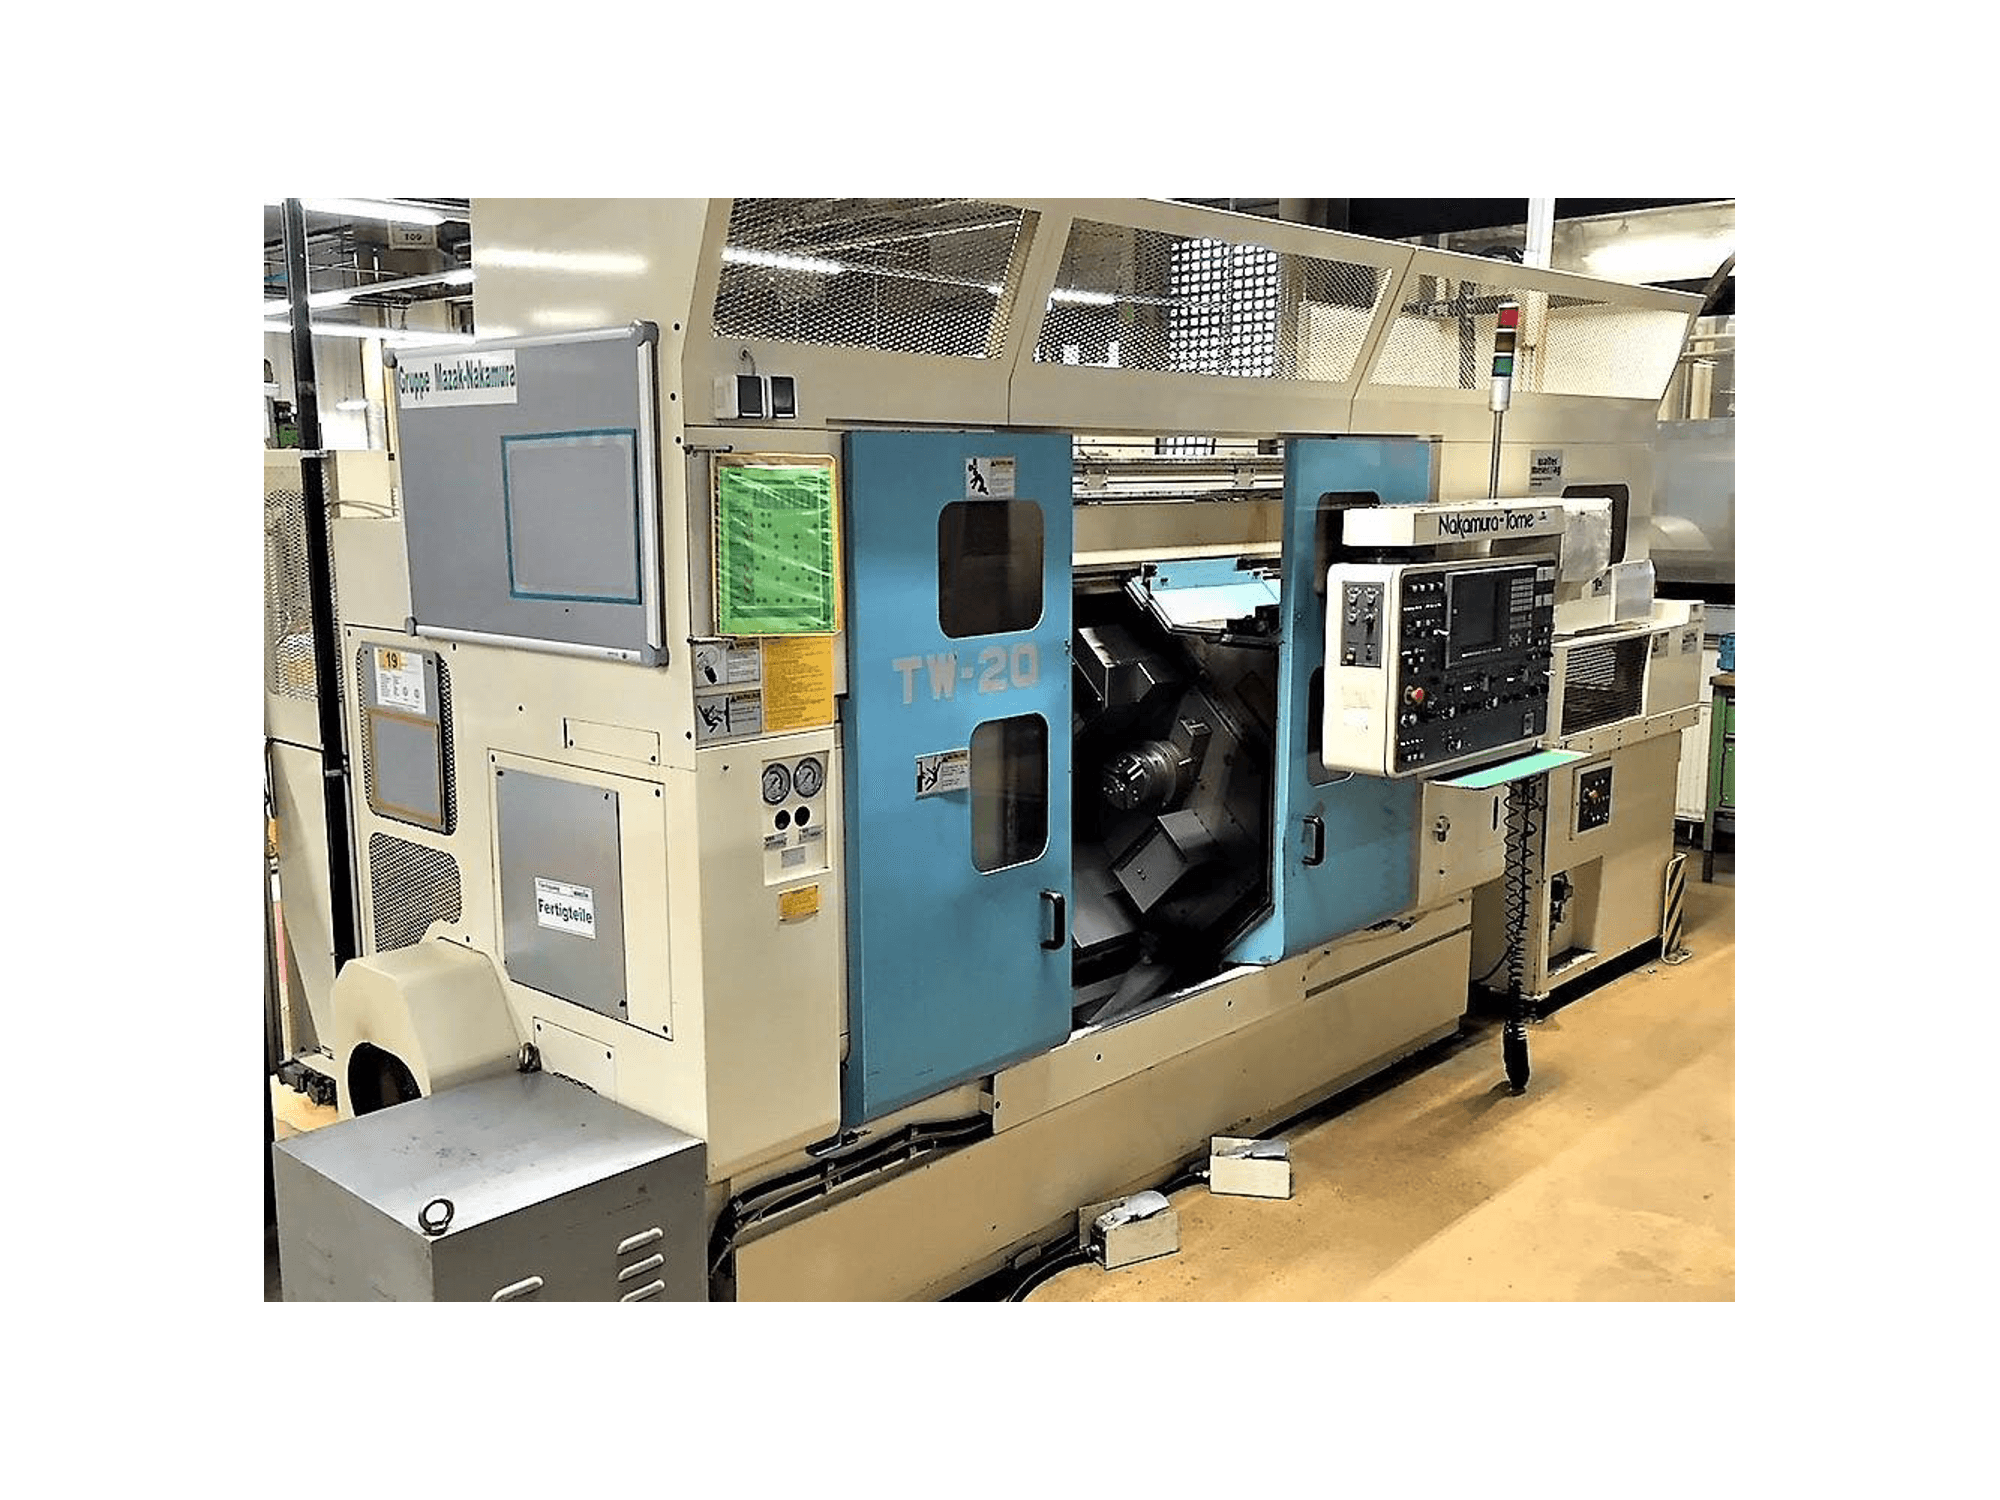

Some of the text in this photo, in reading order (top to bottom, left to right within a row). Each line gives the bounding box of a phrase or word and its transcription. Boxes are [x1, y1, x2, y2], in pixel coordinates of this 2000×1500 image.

[399, 360, 515, 400] Gruppe Mazak-Nakamura
[1438, 509, 1534, 539] Nakamura-Tome
[386, 651, 398, 668] 19
[892, 643, 1038, 705] TW-20
[538, 898, 592, 924] Fertigteile
